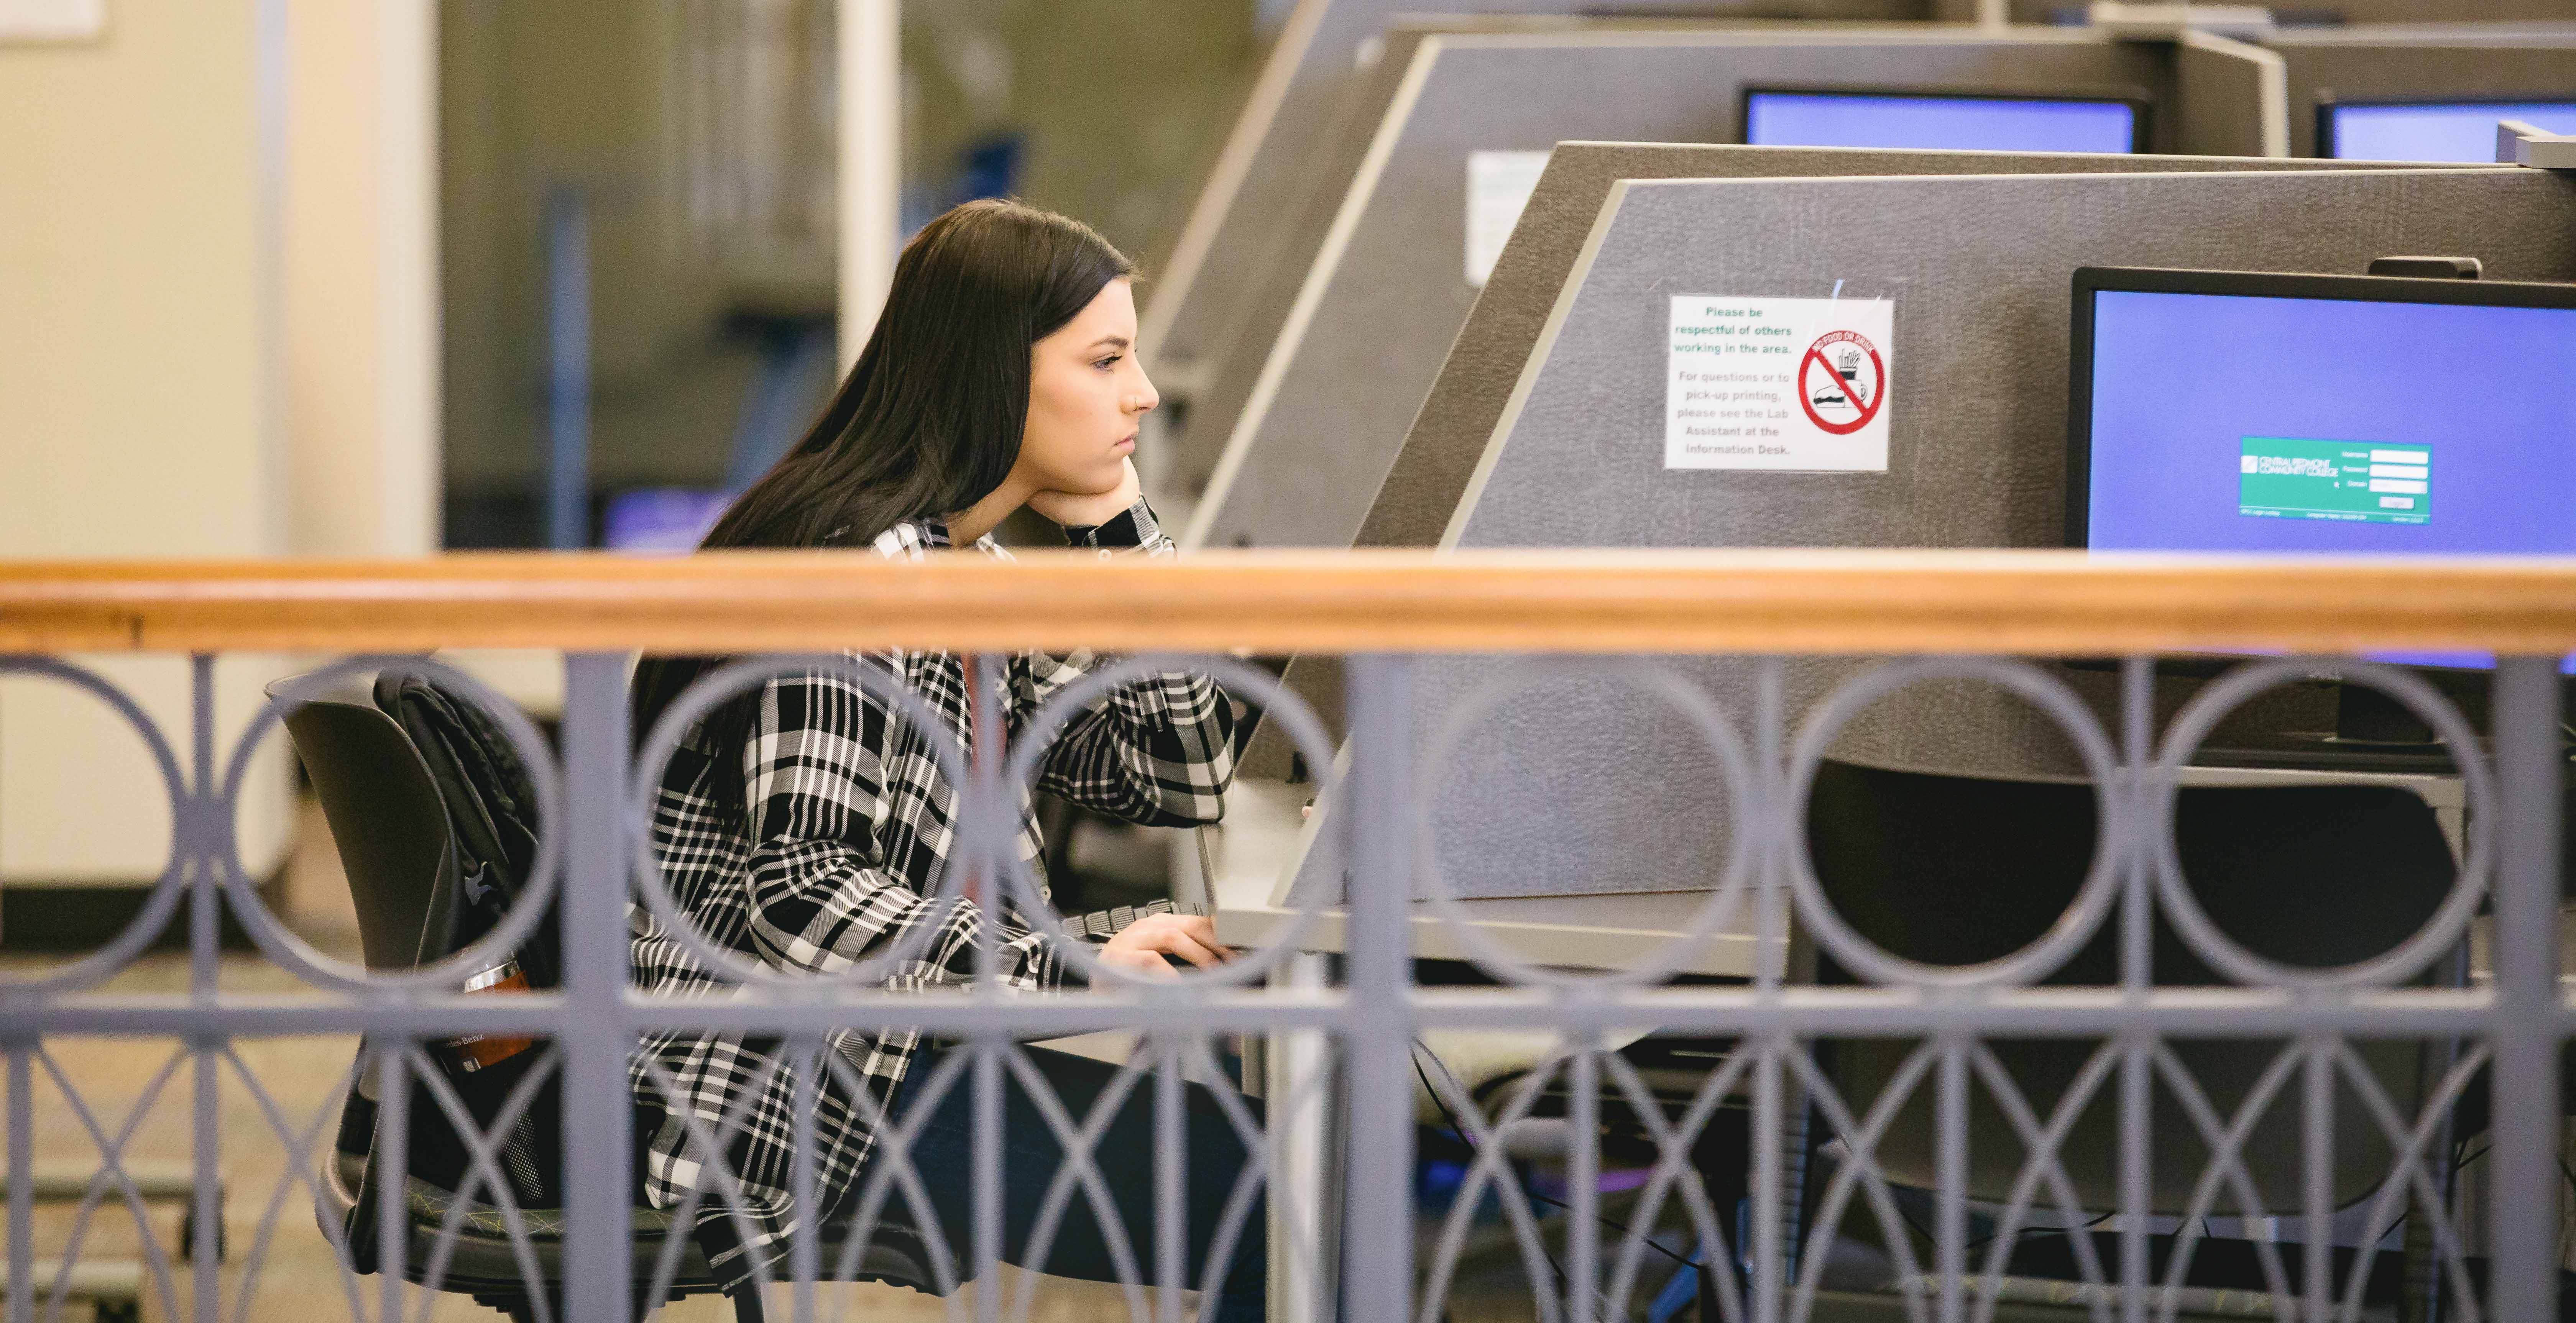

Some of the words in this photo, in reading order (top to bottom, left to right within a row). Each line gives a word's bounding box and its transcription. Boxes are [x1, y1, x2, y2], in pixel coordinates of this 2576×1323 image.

[1706, 307, 1744, 317] Please
[1749, 308, 1762, 317] be
[1676, 325, 1734, 336] respectful
[1739, 326, 1750, 335] of
[1755, 327, 1791, 336] others
[1813, 340, 1824, 351] NO
[1824, 332, 1842, 344] FOOD
[1844, 332, 1854, 341] OR
[1855, 335, 1875, 353] DRINK
[1674, 343, 1721, 355] working
[1725, 343, 1735, 352] in
[1740, 344, 1758, 353] the
[1679, 371, 1697, 381] For
[1702, 373, 1758, 383] questions
[1763, 374, 1775, 382] or
[1778, 374, 1789, 382] to
[1686, 391, 1728, 401] pick-up
[1733, 391, 1781, 403] printing,
[1677, 408, 1716, 419] please
[1745, 409, 1763, 418] the
[1768, 409, 1788, 419] Lab
[1686, 426, 1741, 436] Assistant
[1745, 427, 1756, 436] at
[1760, 427, 1779, 437] the
[1686, 444, 1754, 454] Information
[1758, 445, 1790, 454] Desk.
